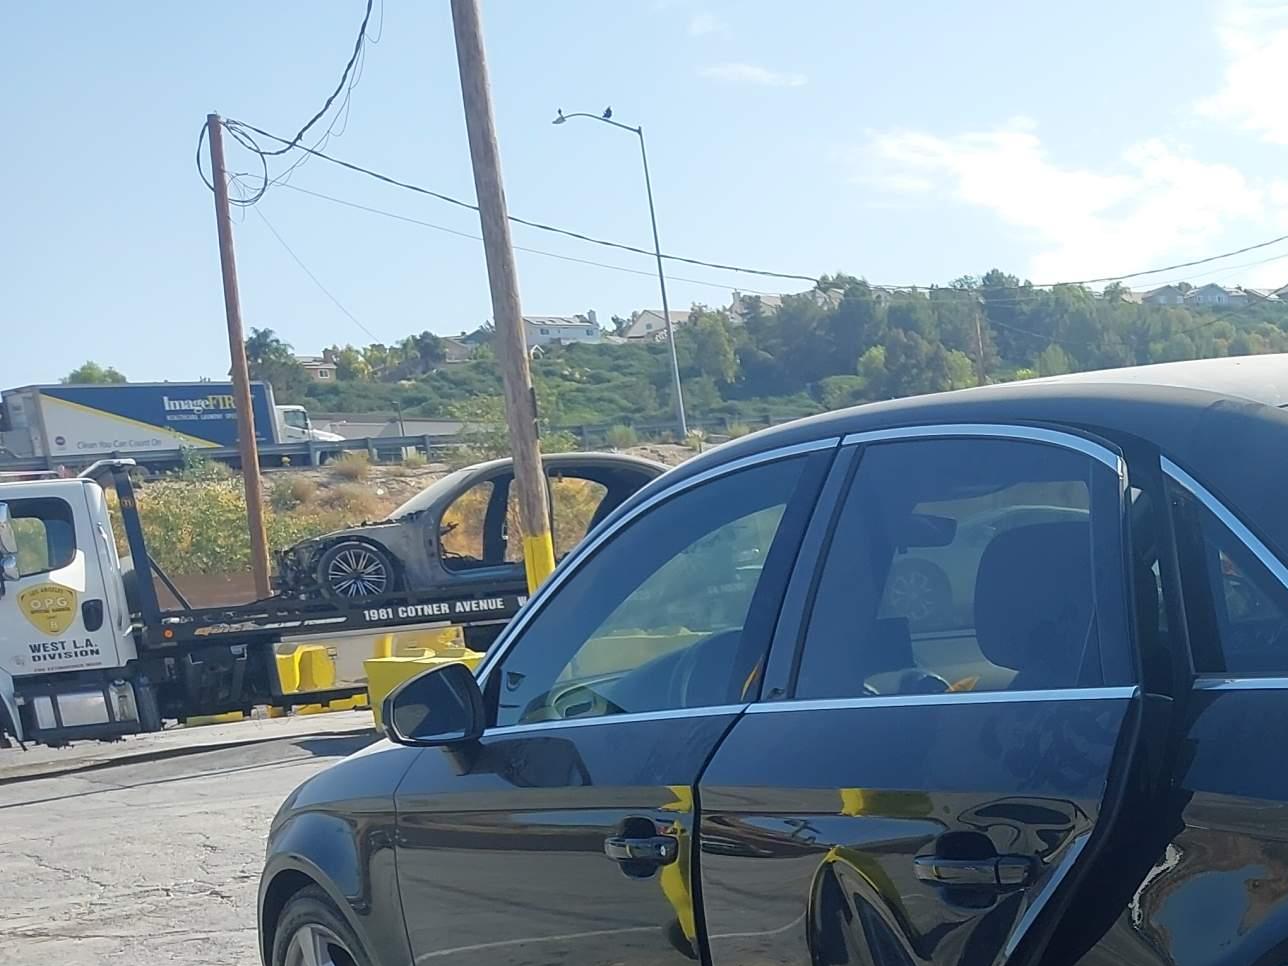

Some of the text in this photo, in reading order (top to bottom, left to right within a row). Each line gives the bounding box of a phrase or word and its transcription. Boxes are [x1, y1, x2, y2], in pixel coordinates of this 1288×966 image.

[162, 395, 254, 413] ImageFIR
[112, 439, 127, 448] Can
[363, 607, 394, 621] 1981
[398, 603, 450, 618] COTNER
[455, 598, 505, 613] AVENUE
[29, 638, 98, 654] WEST L.A.
[31, 649, 100, 662] DIVISION
